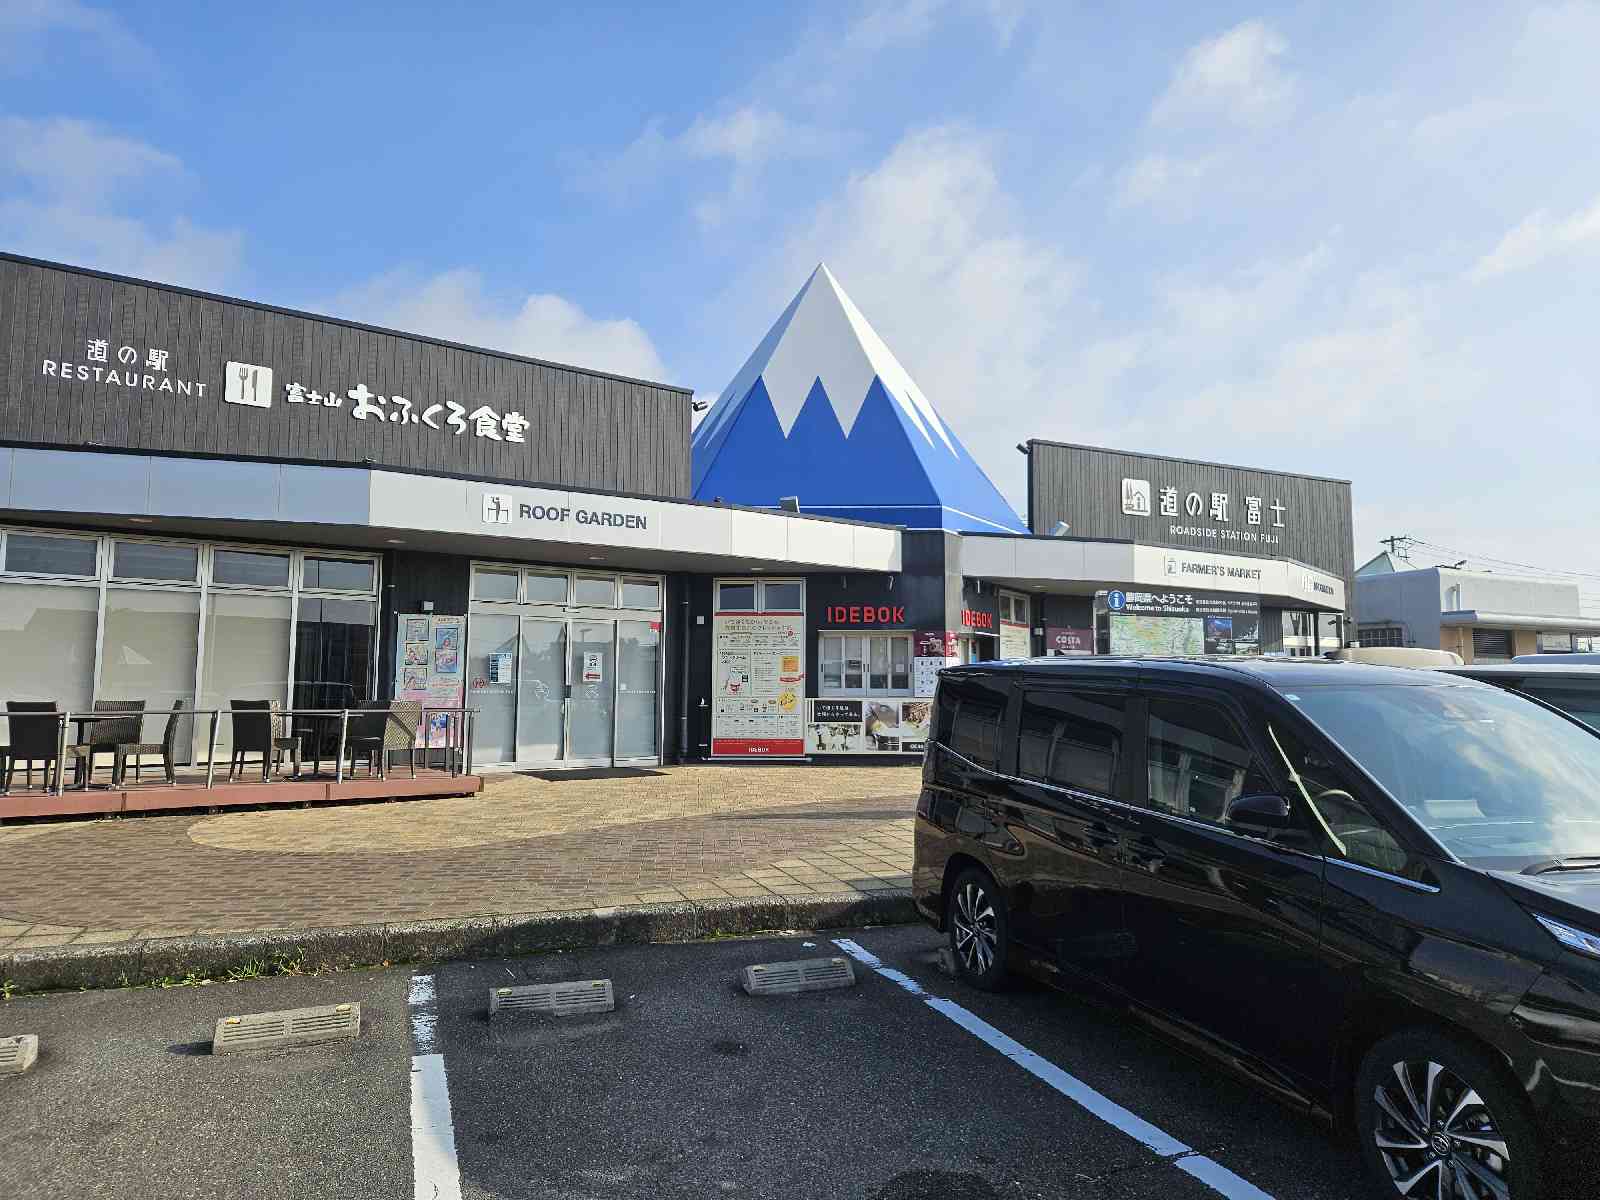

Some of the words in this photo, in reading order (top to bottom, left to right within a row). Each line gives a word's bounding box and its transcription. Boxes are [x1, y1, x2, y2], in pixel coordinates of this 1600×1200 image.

[87, 338, 169, 372] 道の駅
[42, 359, 207, 398] RESTAURANT
[285, 382, 343, 408] 富士山
[347, 383, 530, 443] おふくろ食堂
[519, 503, 571, 522] ROOF
[575, 509, 648, 530] GARDEN
[1159, 485, 1229, 522] 道の駅
[1245, 495, 1287, 528] 富士
[1169, 525, 1217, 538] ROADSIDE
[1219, 529, 1257, 542] STATION
[1260, 533, 1279, 544] FUJI
[1181, 562, 1225, 577] FARMER'S
[1227, 566, 1262, 580] MARKET
[826, 606, 905, 624] IDEBOK
[961, 609, 993, 629] IDEBOK
[1055, 634, 1081, 646] COSTA
